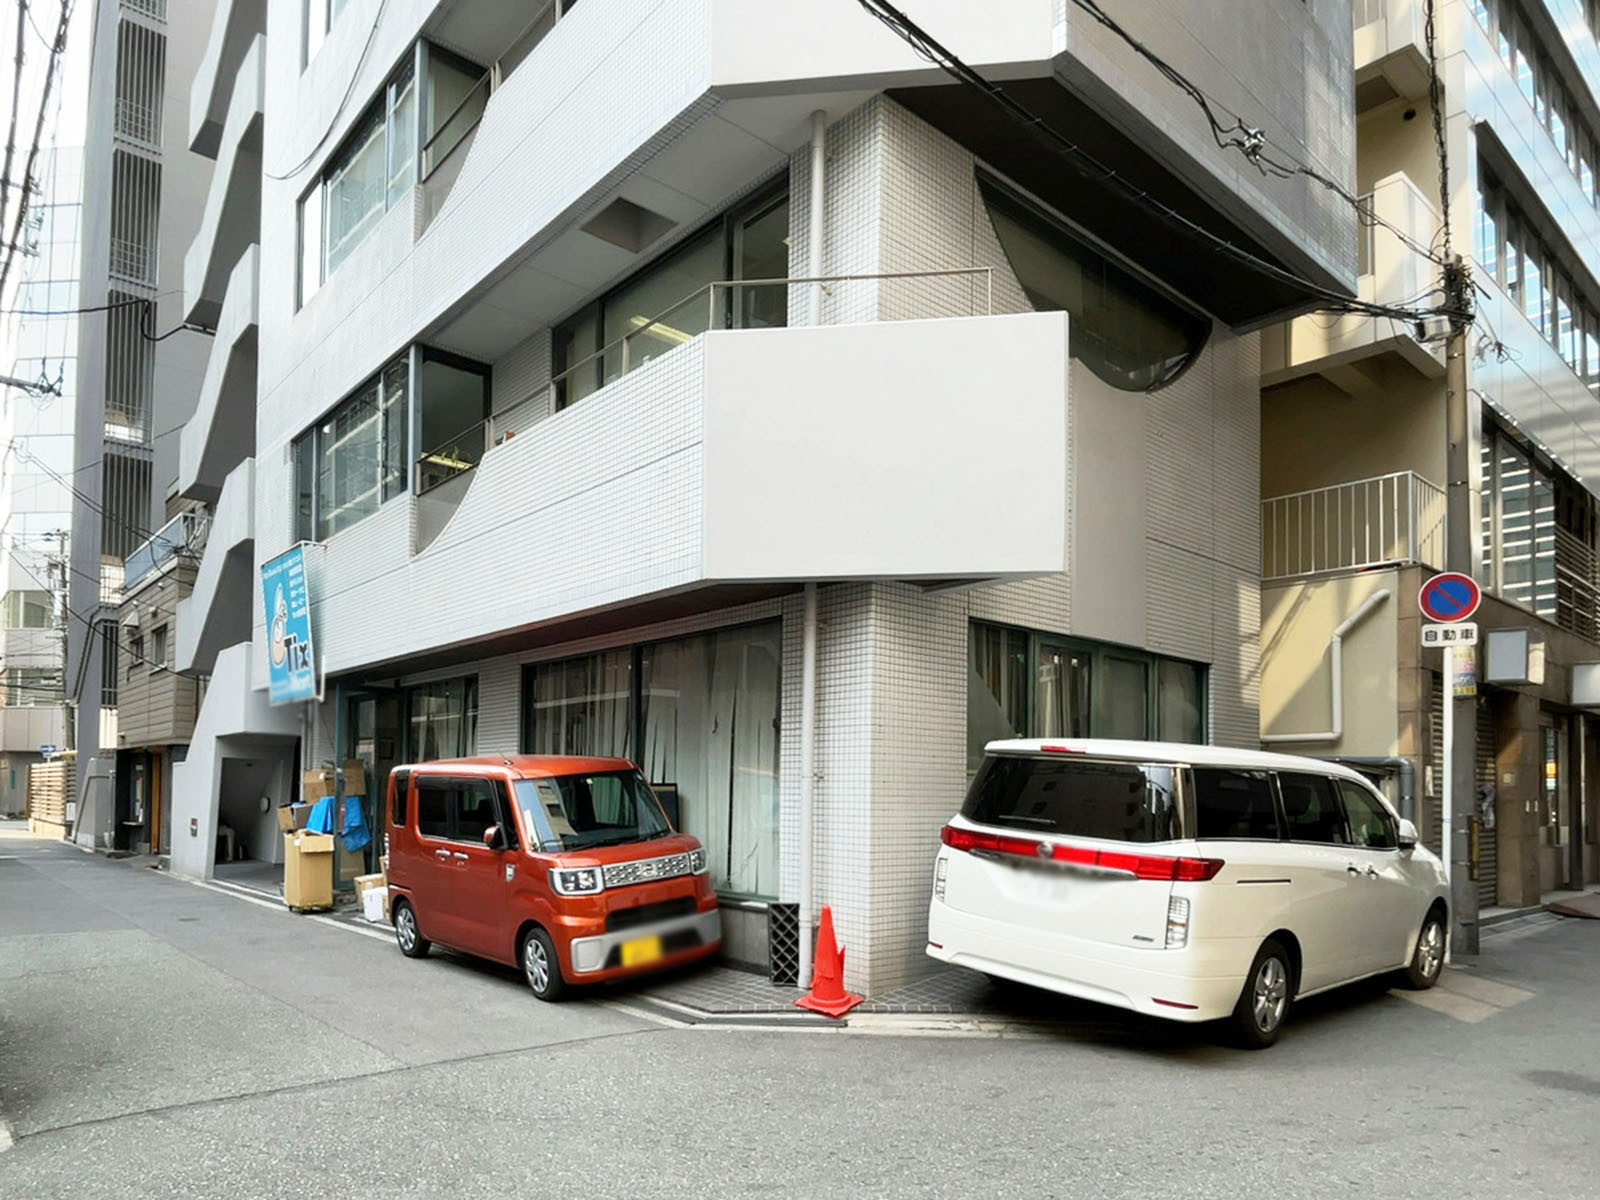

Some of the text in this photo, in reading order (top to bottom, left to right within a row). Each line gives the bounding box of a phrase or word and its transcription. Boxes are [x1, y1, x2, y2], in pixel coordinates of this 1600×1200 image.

[1425, 628, 1474, 642] 自動車
[284, 635, 309, 672] Tix
